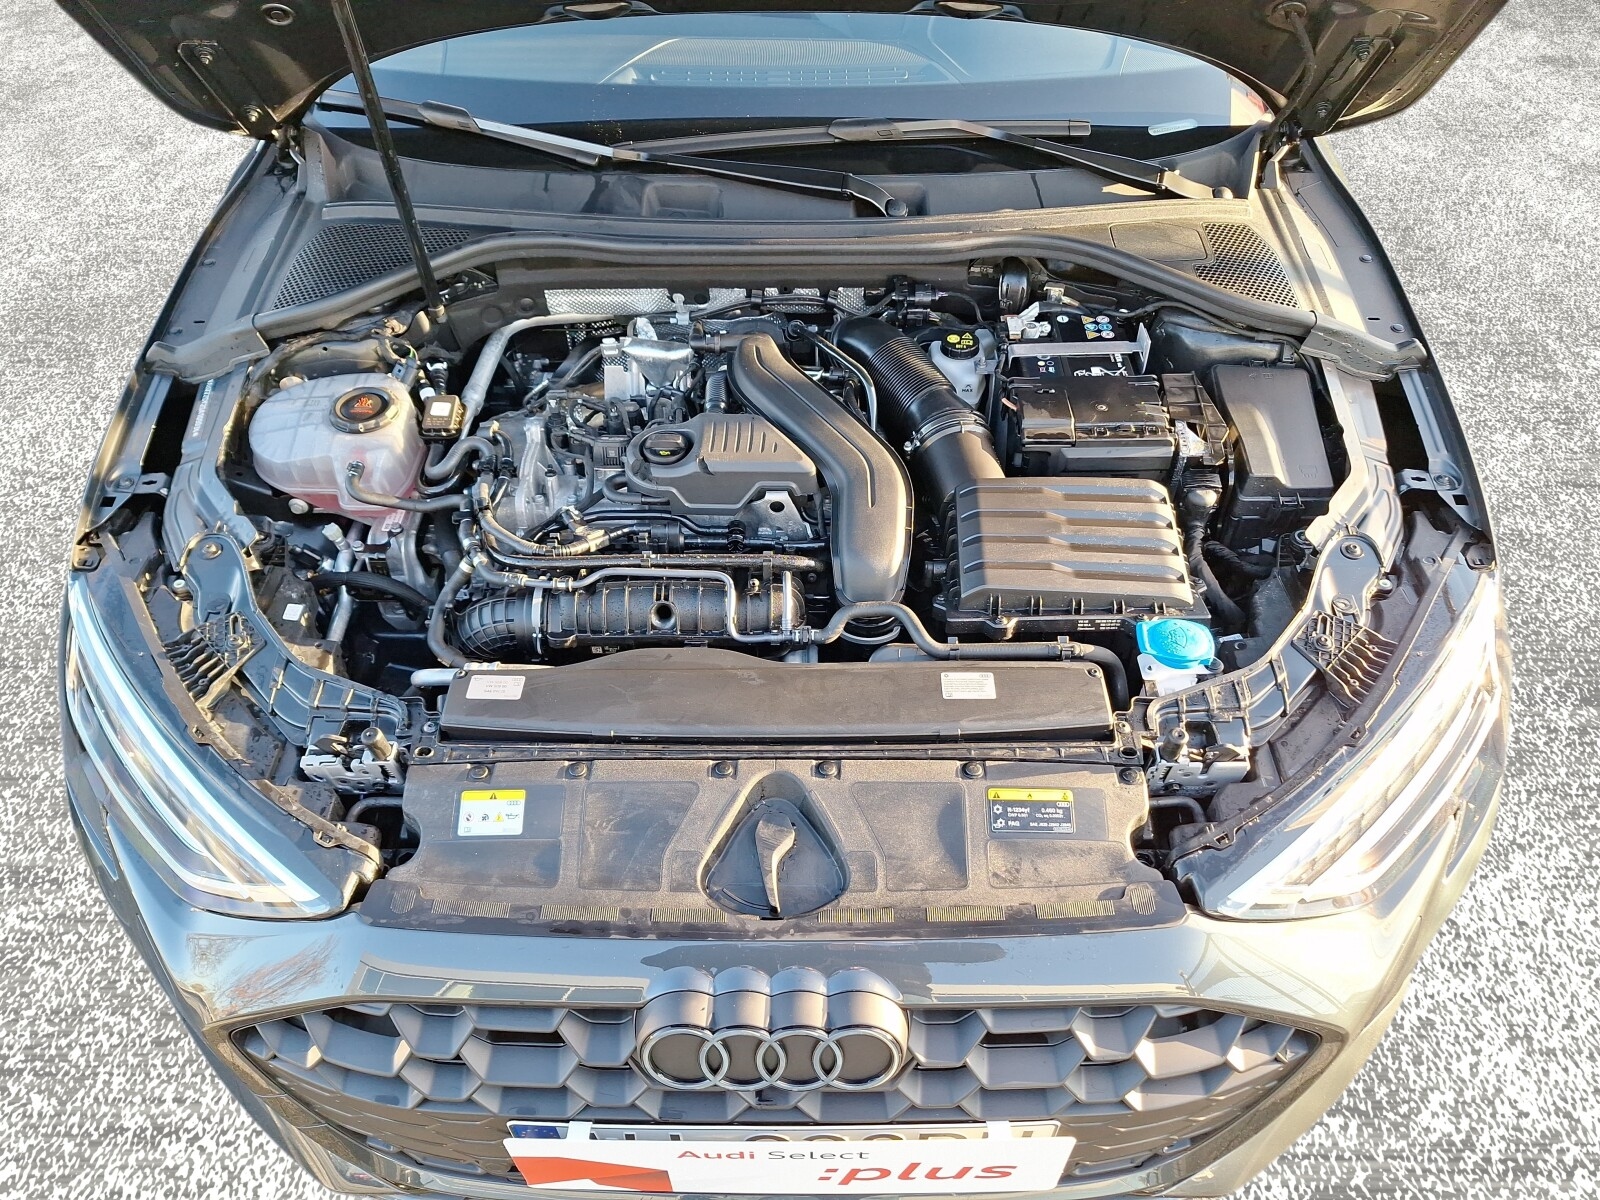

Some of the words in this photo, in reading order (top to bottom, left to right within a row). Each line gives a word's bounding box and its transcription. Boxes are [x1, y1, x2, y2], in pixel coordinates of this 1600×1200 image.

[677, 1150, 755, 1160] Audi
[768, 1151, 870, 1160] Select
[817, 1162, 1018, 1185] :plus
